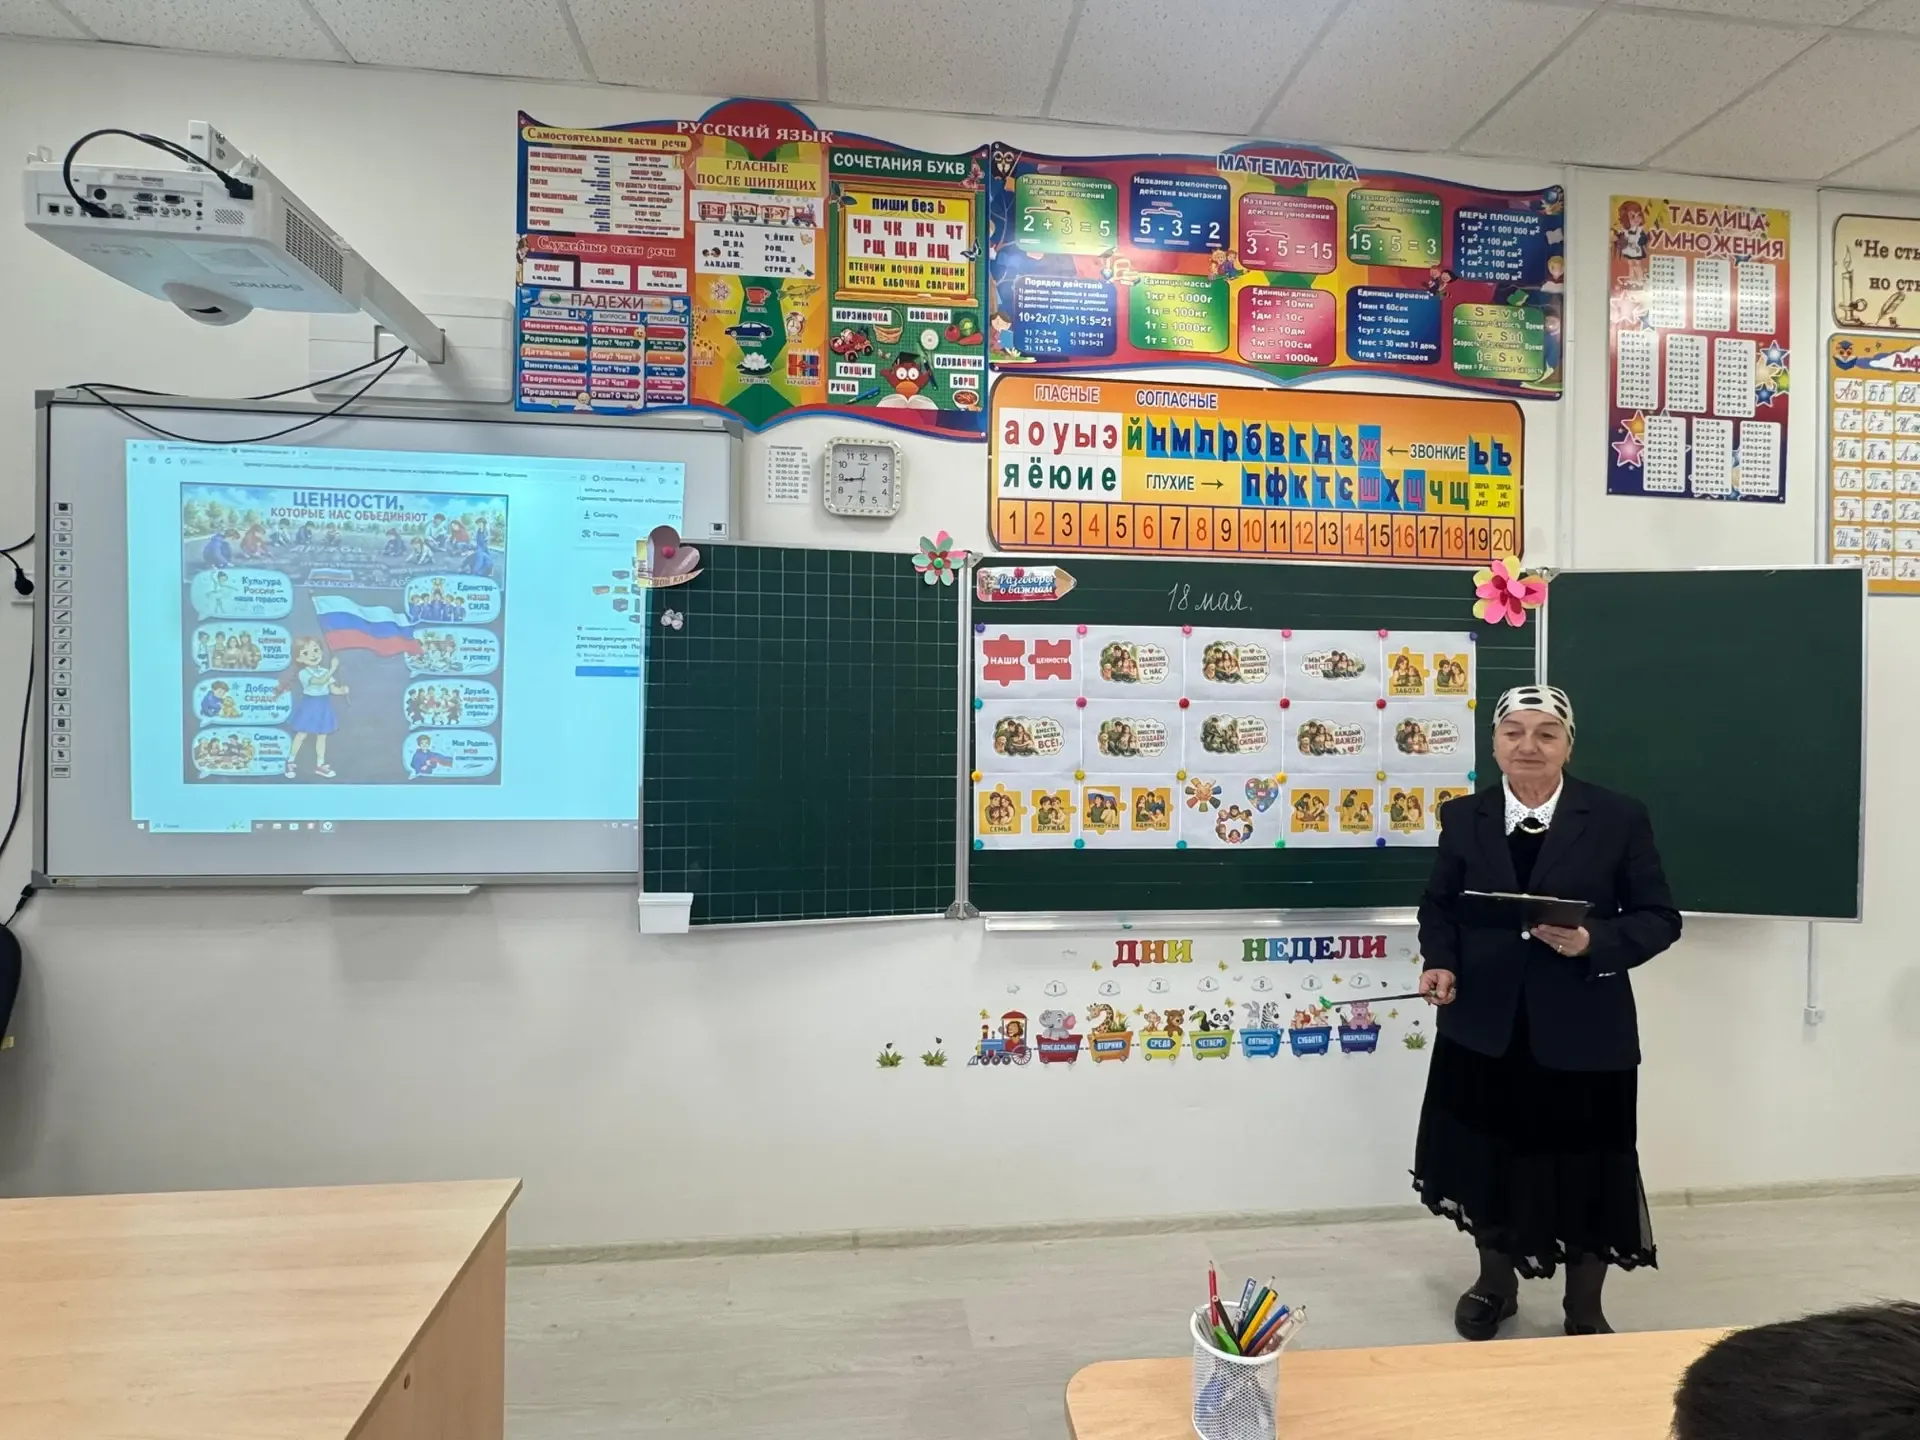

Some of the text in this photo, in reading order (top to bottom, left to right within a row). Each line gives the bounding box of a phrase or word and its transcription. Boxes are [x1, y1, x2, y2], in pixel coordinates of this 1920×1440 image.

[527, 128, 687, 150] Самостоятельные части речи
[676, 121, 834, 144] РУССКИЙ ЯЗЫК
[726, 160, 789, 174] ГЛАСНЫЕ
[834, 153, 965, 175] СОЧЕТАНИЯ БУКВ
[1218, 154, 1359, 181] МАТЕМАТИКА
[697, 174, 817, 191] ПОСЛЕ ШИПЯЩИХ
[1134, 176, 1228, 190] Название компонентов
[1139, 188, 1222, 200] действия вычитания
[872, 198, 908, 212] пиши
[912, 198, 934, 214] без
[1459, 211, 1538, 224] МЕРЫ ПЛОЩАДИ
[1668, 205, 1767, 232] ТАБЛИЦА
[853, 218, 963, 240] ЧН ЧК НЧ ЧТ
[538, 236, 676, 258] Служебные части речи
[864, 239, 950, 261] РЩ ЩН НЩ
[1649, 229, 1785, 259] УМНОЖЕНИЯ
[534, 263, 678, 280] ПРЕДЛОГ СОЮЗ ЧАСТИЦА
[848, 261, 965, 277] ПТЕНЧИК НОЧНОЙ ХИЩНИК
[848, 275, 966, 291] МЕЧТА БАБОЧКА СВАРЩИК
[1024, 277, 1103, 290] Порядок действий
[1869, 278, 1890, 290] но
[1252, 288, 1318, 299] Единицы длины
[1358, 289, 1430, 300] Единицы времени
[570, 293, 644, 310] ПАДЕЖИ
[835, 310, 950, 322] КОРЗИНОЧКА ОВОЩНОЙ
[525, 322, 628, 334] Именительный Кто? Что?
[936, 357, 984, 368] ОДУВАНЧИК
[839, 364, 872, 378] ГОНЩИК
[524, 374, 583, 385] Творительный
[952, 375, 976, 388] БОРЩ
[830, 381, 856, 393] РУЧКА
[1034, 384, 1218, 410] ГЛАСНЫЕ СОГЛАСНЫЕ
[1410, 444, 1466, 460] ЗВОНКИЕ
[838, 474, 844, 482] 9
[1146, 474, 1194, 490] ГЛУХИЕ
[882, 488, 888, 496] 4
[293, 492, 404, 511] ЦЕННОСТИ,
[860, 496, 865, 504] 6
[872, 496, 878, 504] 5
[270, 508, 428, 523] КОТОРЫЕ НАС ОБЪЕДИНЯЮТ
[1010, 510, 1512, 552] 1 2 3 4 5 6 7 8 9 10 11 12 13 14 15 16 17 18 19 20
[1000, 574, 1054, 587] Разговоры
[1008, 584, 1054, 594] важном
[1168, 582, 1190, 612] 18
[468, 602, 490, 611] сила
[262, 628, 277, 636] Мы
[263, 645, 282, 654] труд
[990, 656, 1018, 664] НАШИ
[1037, 824, 1066, 832] ДРУЖБА
[1113, 936, 1387, 968] ДНИ НЕДЕЛИ
[1052, 976, 1363, 992] 1 2 3 4 5 6 7
[1041, 1034, 1375, 1052] ПОНЕДЕЛЬНИК ВТОРНИК СРЕДА ЧЕТВЕРГ ПЯТНИЦА СУББОТА ВОСКРЕСЕНЬЕ
